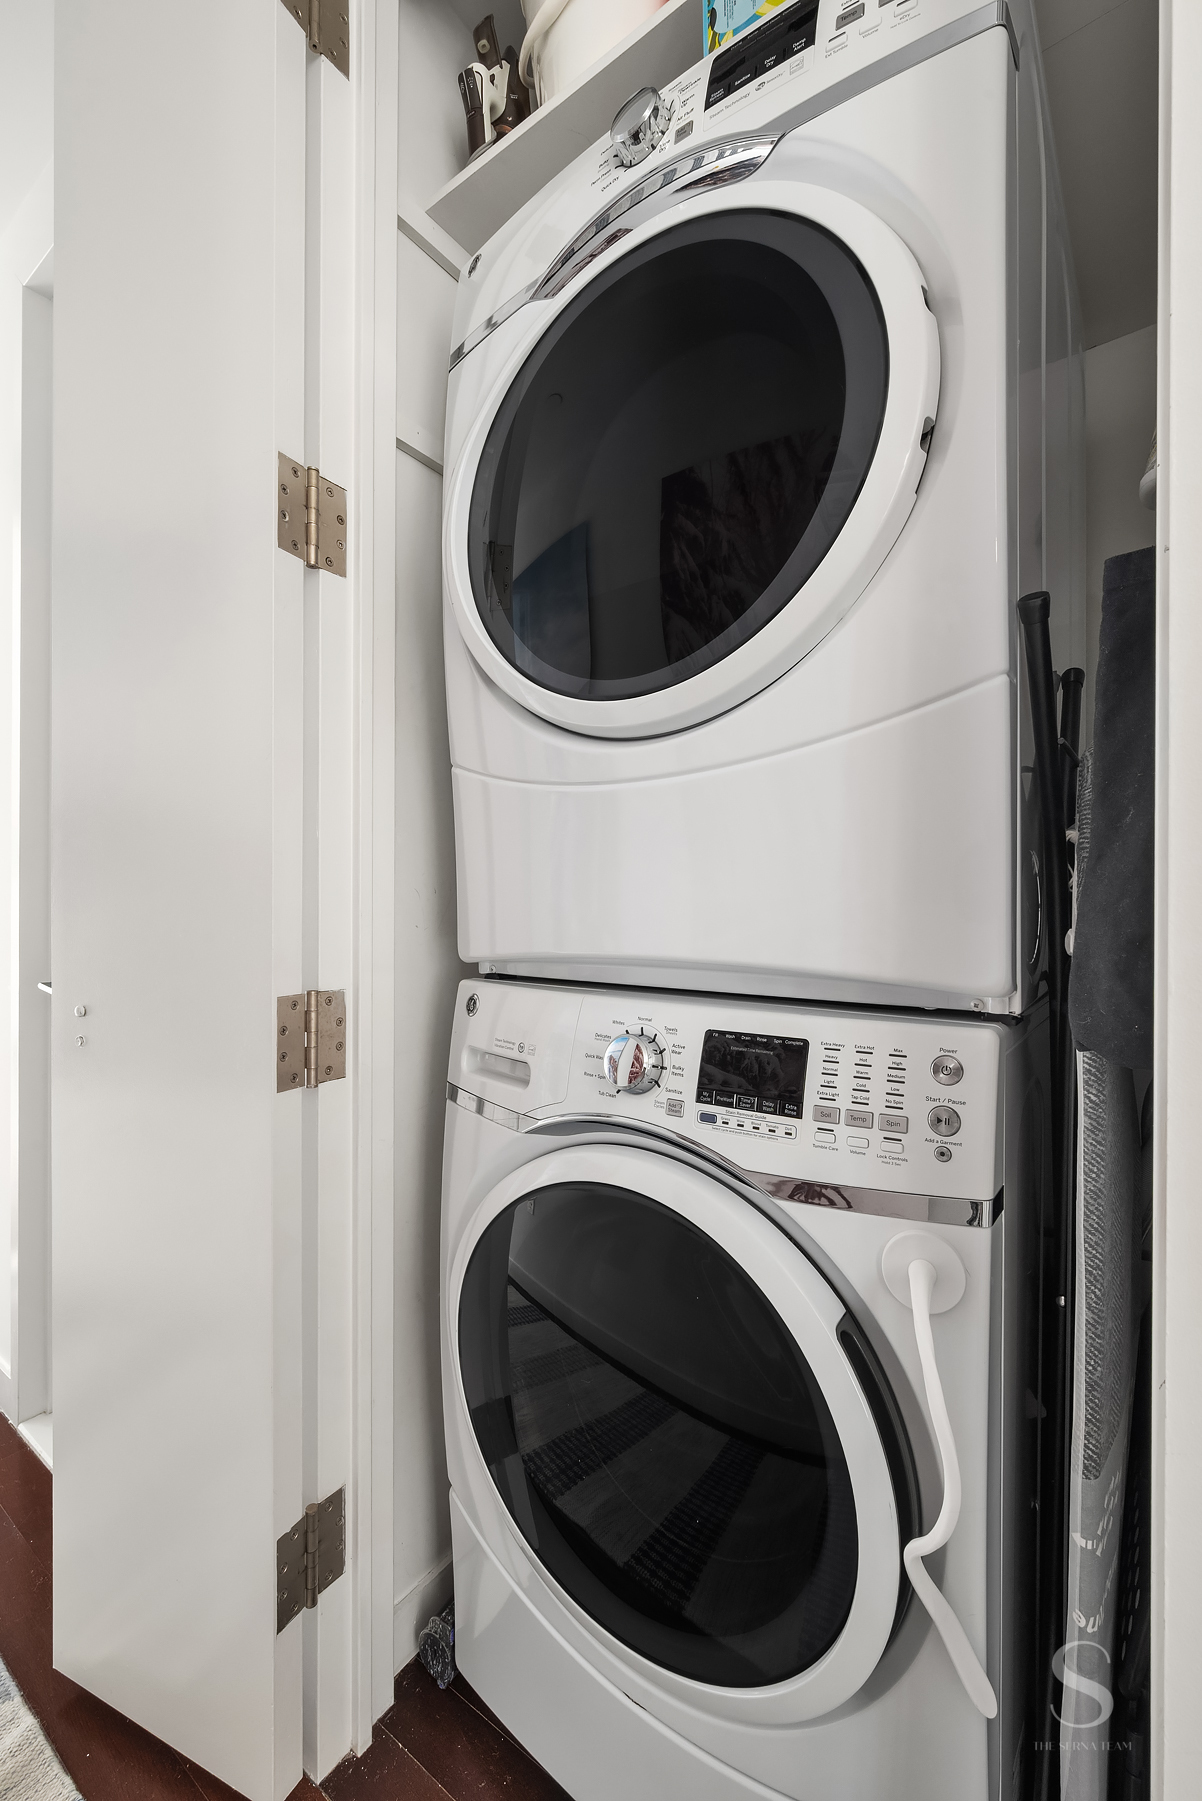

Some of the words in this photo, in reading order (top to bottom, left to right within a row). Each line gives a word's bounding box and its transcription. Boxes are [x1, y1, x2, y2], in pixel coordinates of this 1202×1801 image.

[840, 10, 858, 22] Temp
[862, 28, 879, 38] Volume
[792, 38, 806, 48] Damp
[793, 42, 805, 52] Alert
[724, 92, 751, 110] Technology
[850, 1115, 867, 1123] Temp
[886, 1119, 901, 1128] Spin
